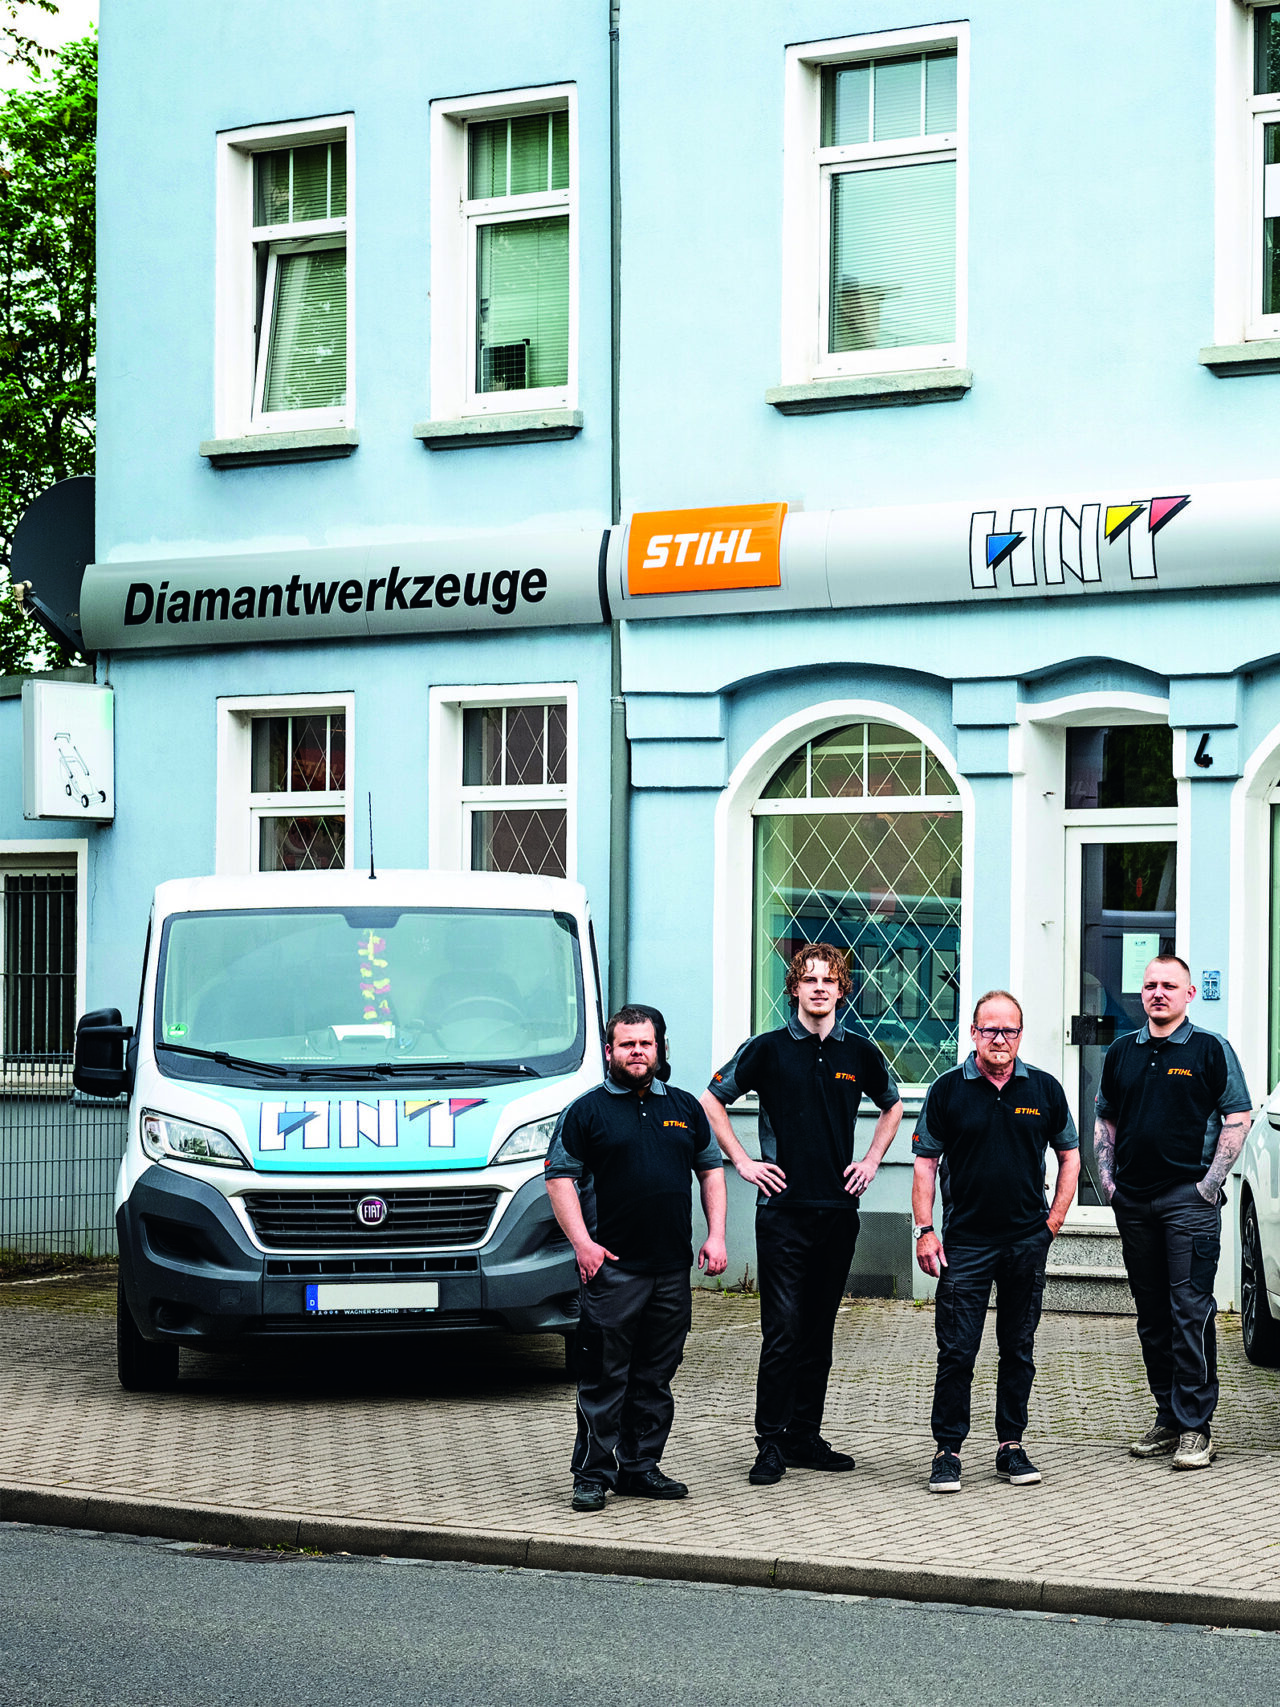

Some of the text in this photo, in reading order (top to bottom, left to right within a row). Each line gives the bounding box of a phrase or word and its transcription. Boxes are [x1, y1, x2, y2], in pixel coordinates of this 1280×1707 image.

[969, 494, 1192, 589] HNT
[642, 528, 762, 569] STIHL
[123, 565, 549, 626] Diamantwerkzeuge
[834, 1072, 856, 1082] STIHL
[1167, 1068, 1193, 1077] STIHL
[1014, 1107, 1041, 1116] STIHL
[662, 1120, 688, 1129] STIHL
[363, 1204, 381, 1219] FIAT
[309, 1299, 316, 1307] D
